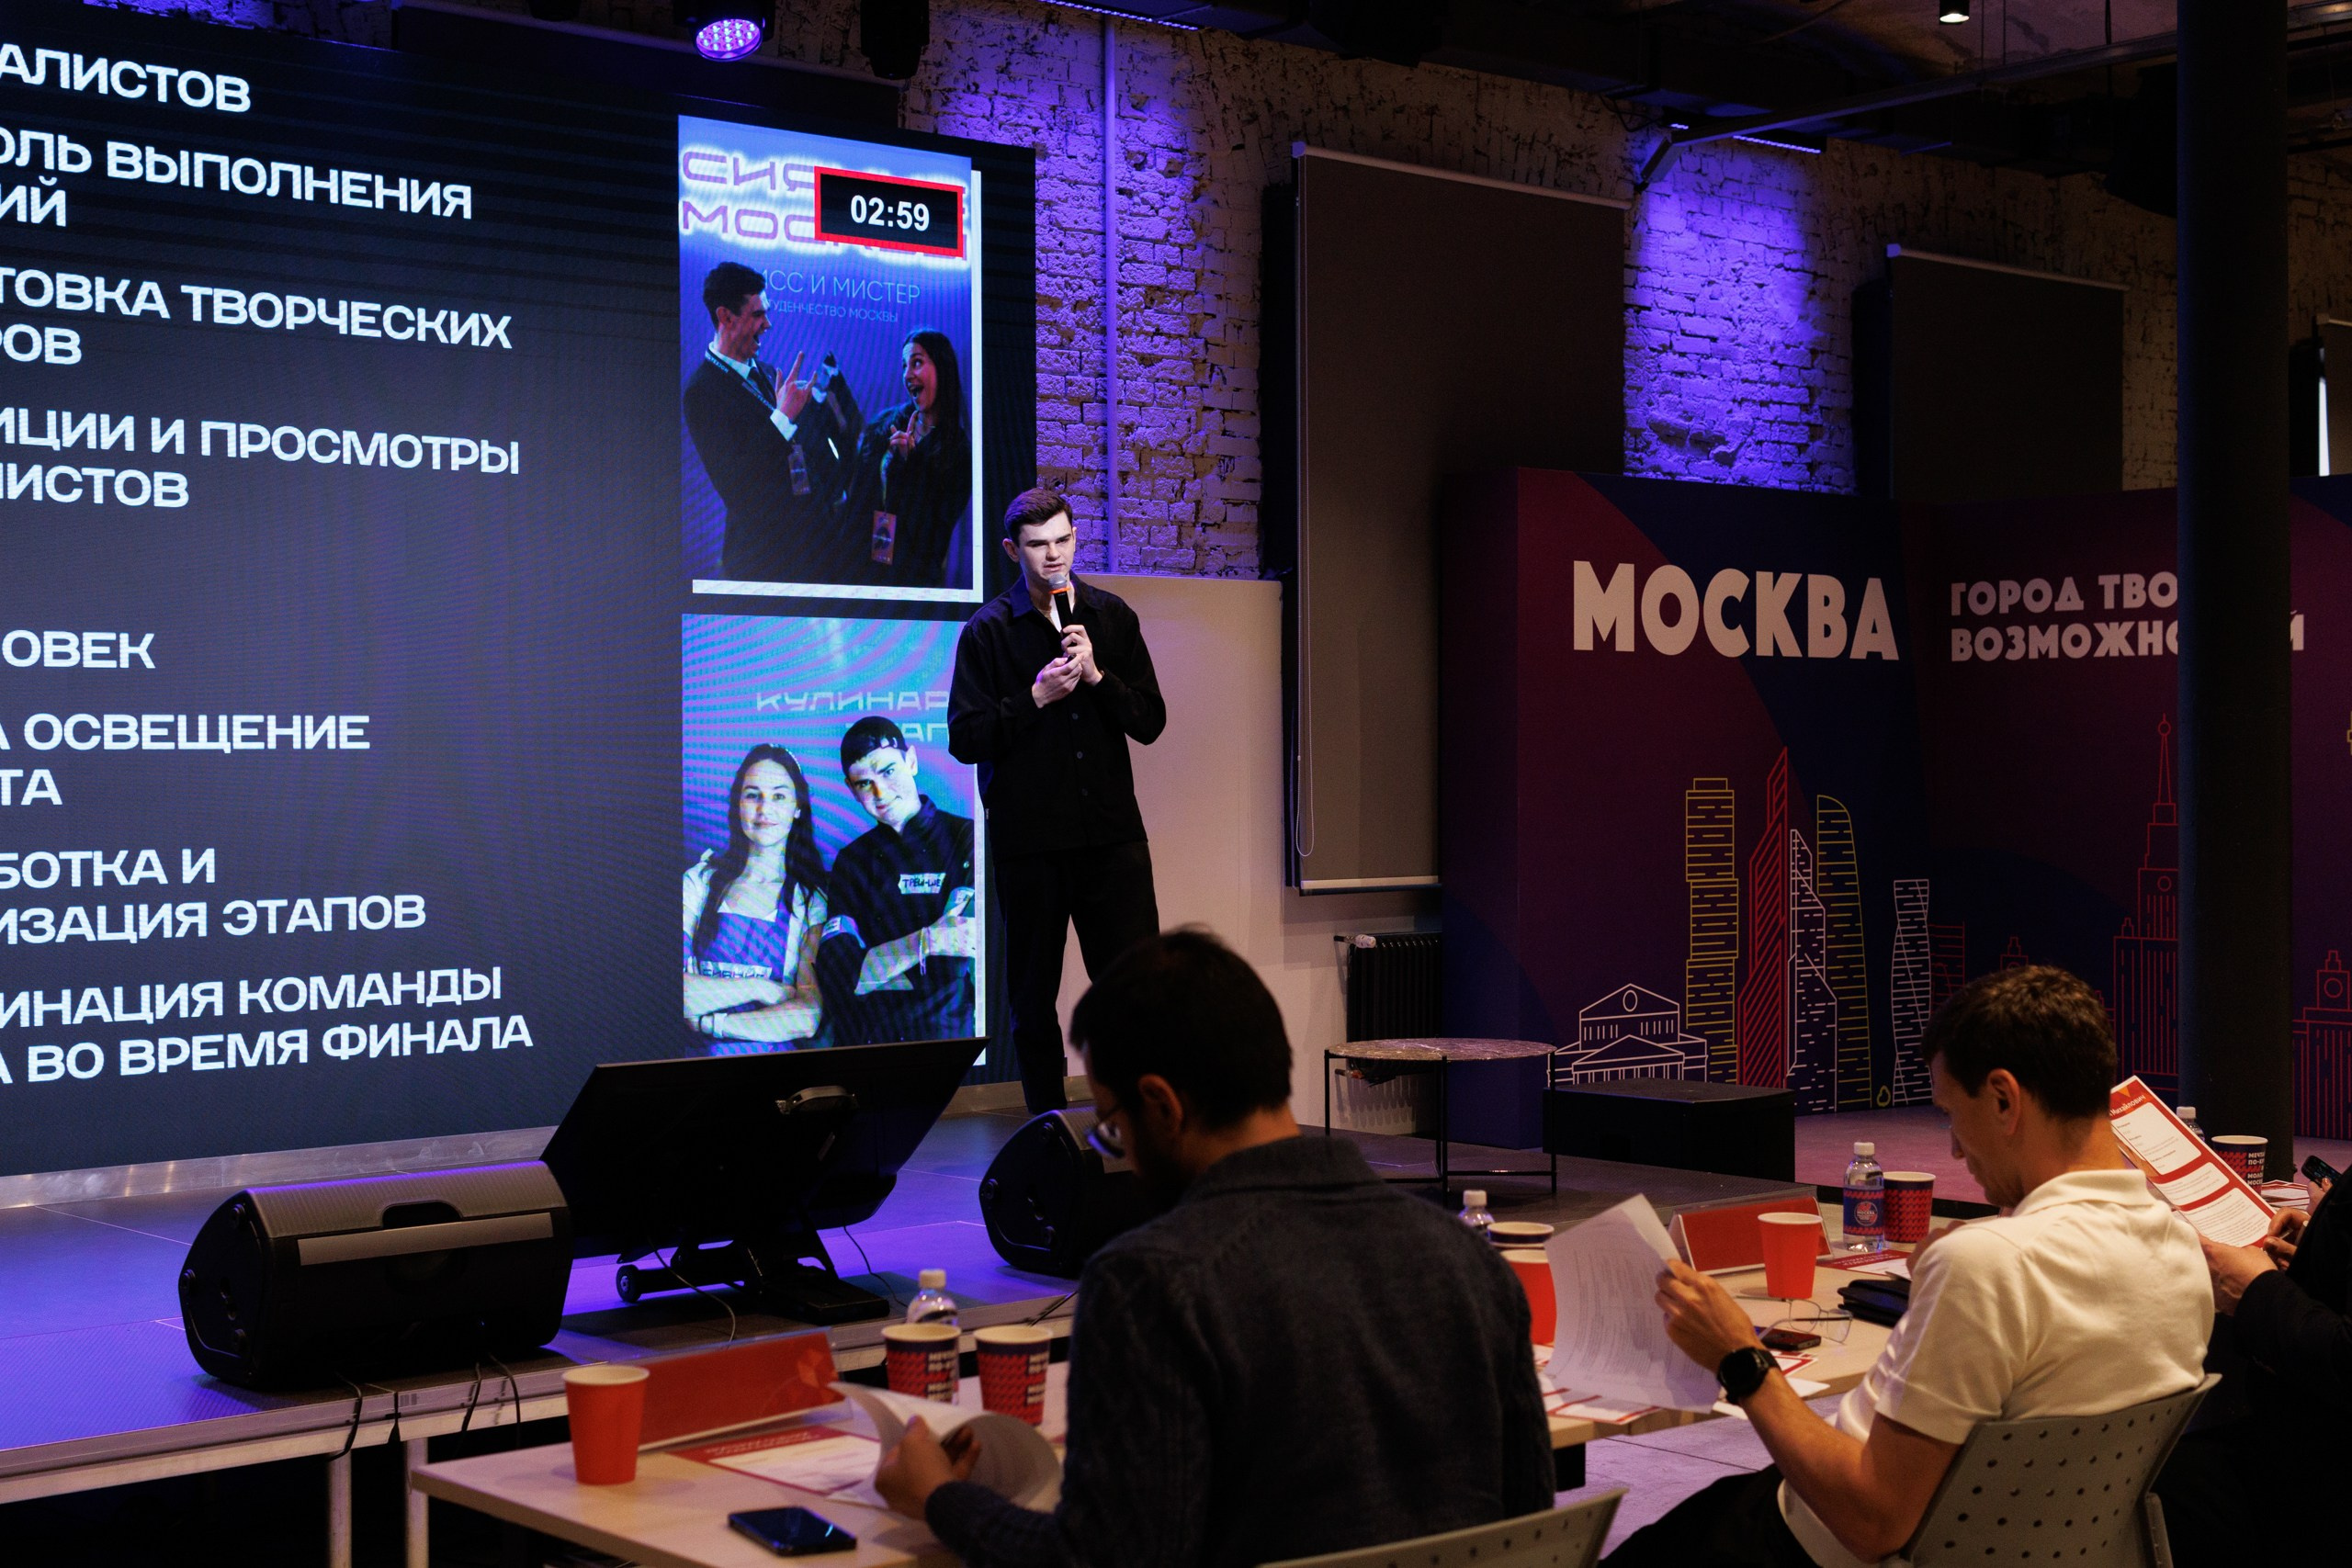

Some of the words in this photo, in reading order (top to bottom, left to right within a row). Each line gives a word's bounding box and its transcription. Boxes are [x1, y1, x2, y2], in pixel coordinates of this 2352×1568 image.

[0, 43, 251, 112] АЛИСТОВ
[107, 141, 472, 220] ВЫПОЛНЕНИЯ
[850, 195, 930, 231] 02:59
[811, 274, 825, 296] И
[833, 276, 921, 304] МИСТЕР
[180, 285, 513, 349] ТВОРЧЕСКИХ
[849, 308, 899, 322] МОСКВЫ
[0, 323, 82, 365] ОВ
[151, 417, 185, 455] И
[200, 421, 519, 475] ПРОСМОТРЫ
[0, 462, 189, 508] ИСТОВ
[1574, 560, 1898, 660] МОСКВА
[1951, 577, 2084, 615] ГОРОД
[2, 629, 156, 669] ОВЕК
[757, 691, 950, 711] КУЛИНАР
[24, 713, 370, 754] ОСВЕЩЕНИЕ
[182, 848, 216, 885] И
[222, 895, 426, 936] ЭТАПОВ
[0, 981, 223, 1029] ИНАЦИЯ
[239, 966, 502, 1015] КОМАНДЫ
[28, 1042, 105, 1082] ВО
[119, 1029, 309, 1076] ВРЕМЯ
[322, 1014, 534, 1060] ФИНАЛА
